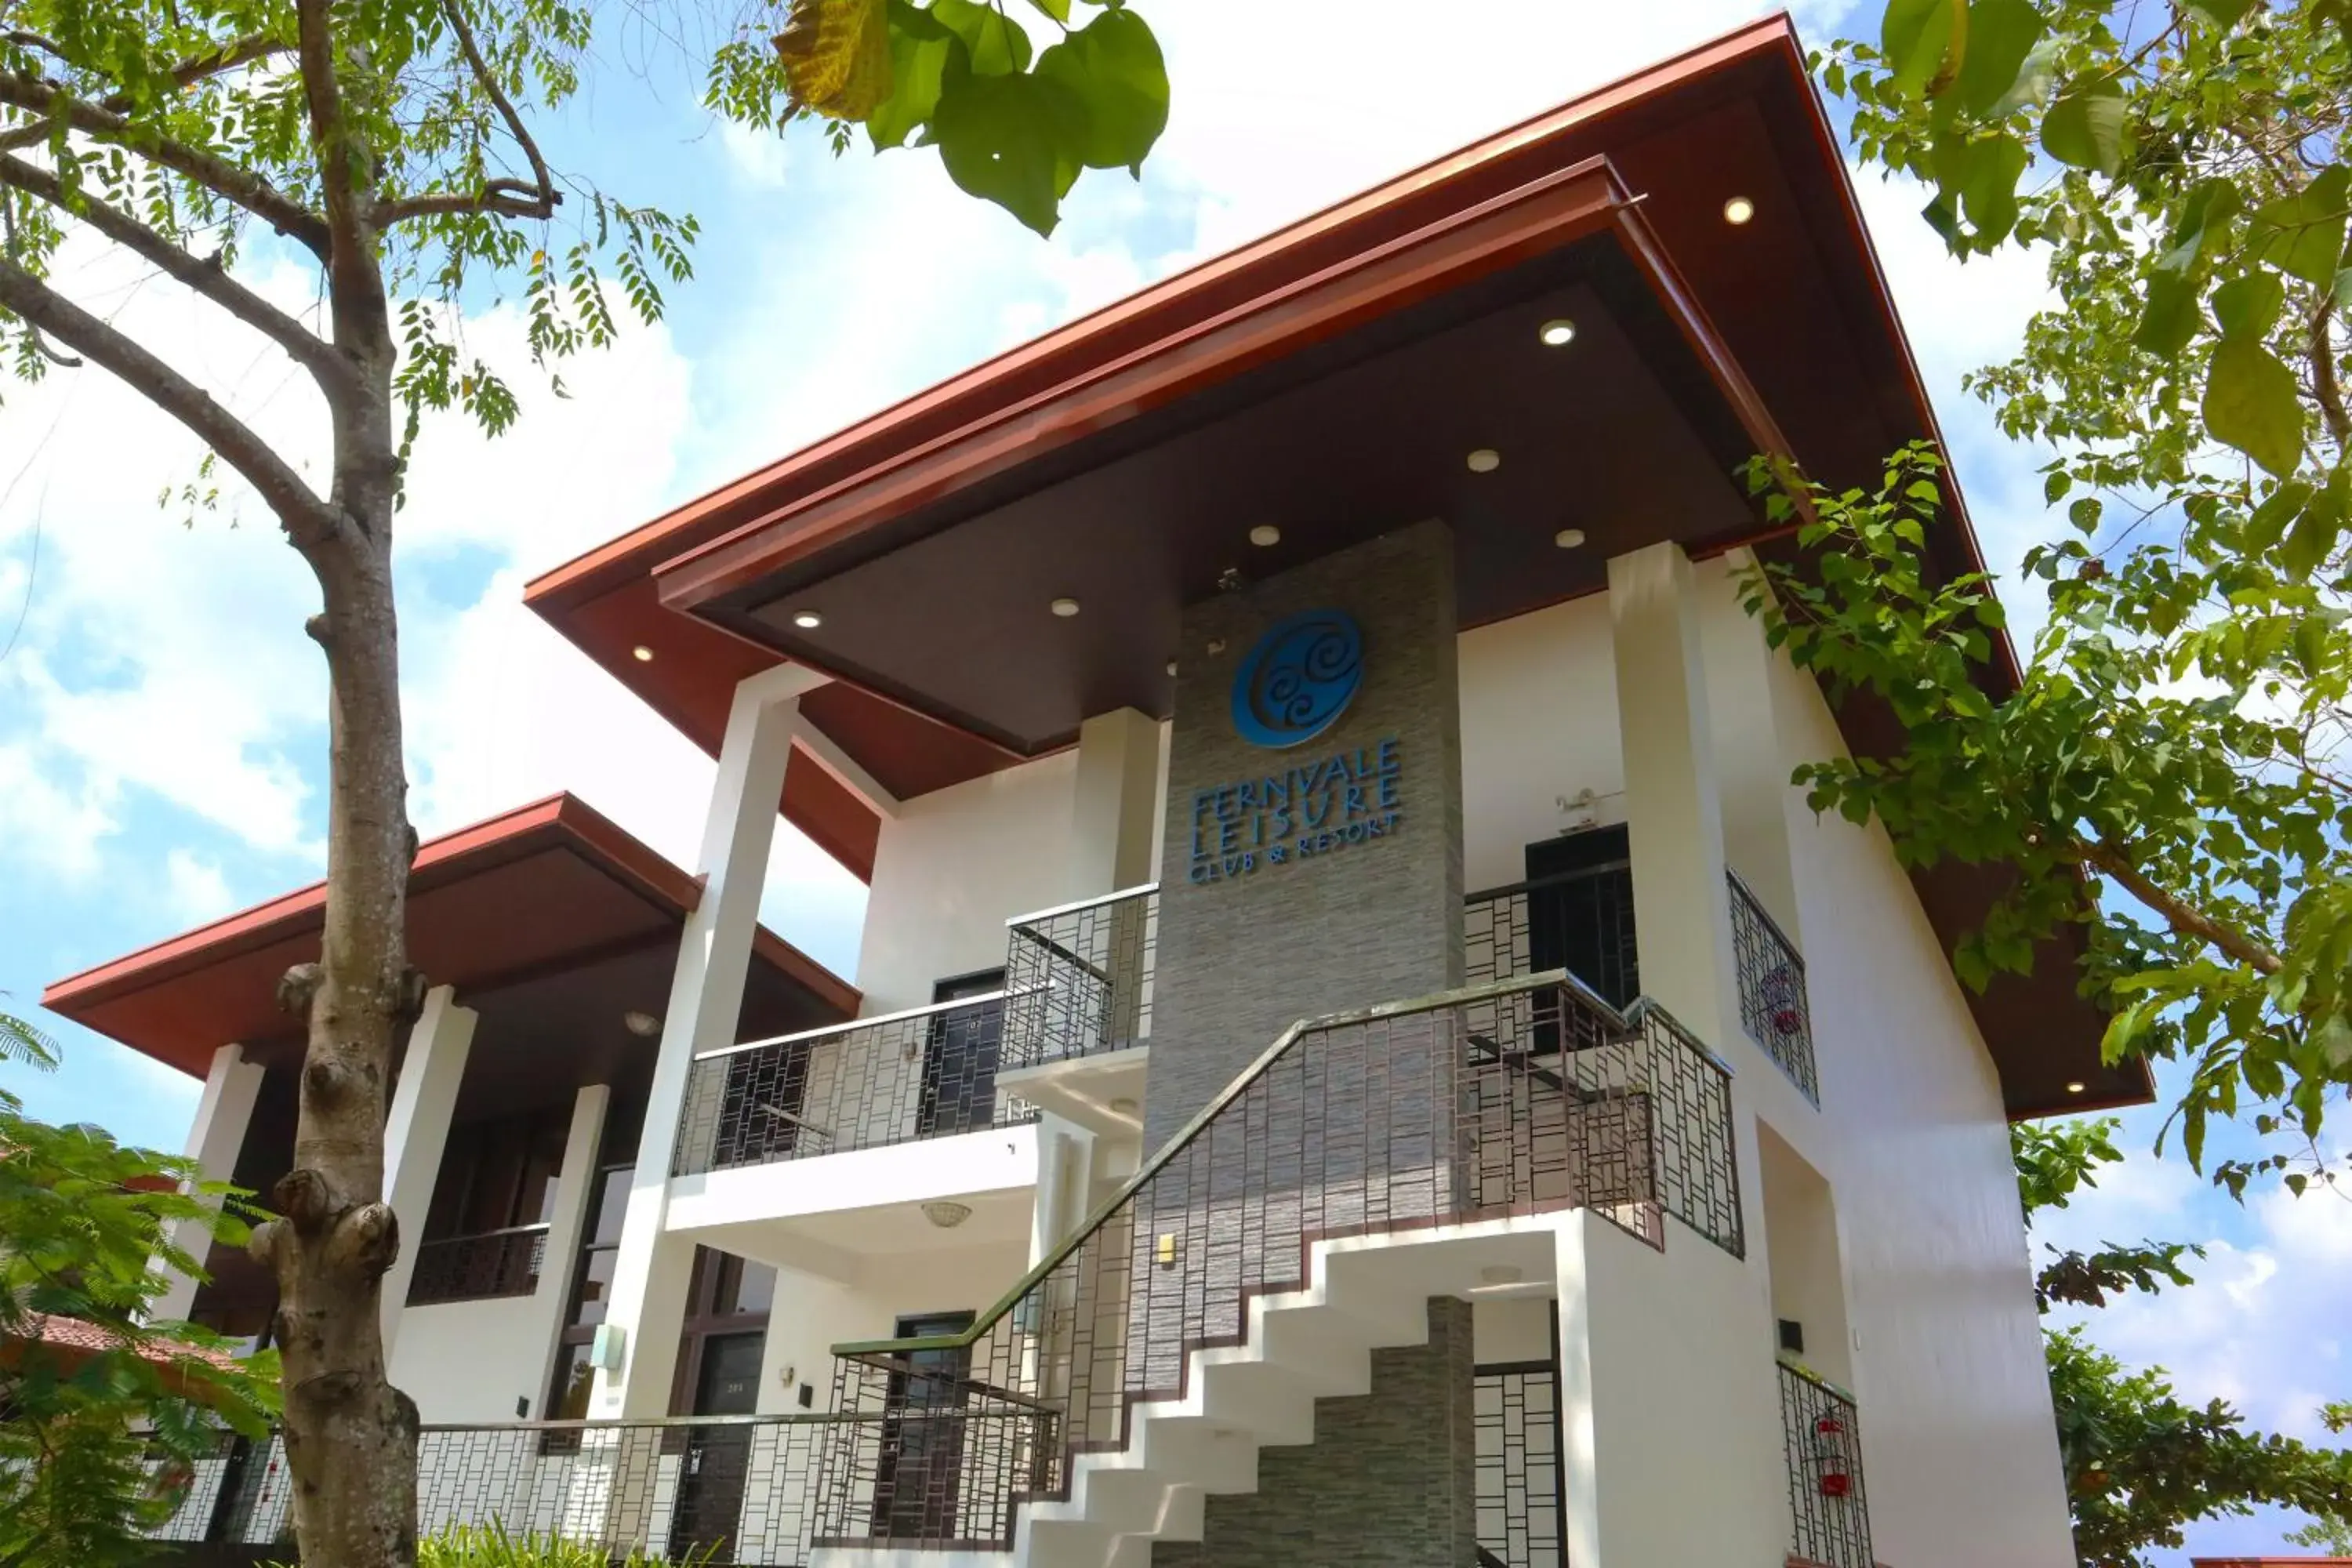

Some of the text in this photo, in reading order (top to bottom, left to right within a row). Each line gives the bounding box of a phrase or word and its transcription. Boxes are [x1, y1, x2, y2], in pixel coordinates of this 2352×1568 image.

[1192, 737, 1399, 825] FERNVALE
[1192, 777, 1399, 861] LEISURE
[1190, 810, 1399, 883] CLUB & RESORT
